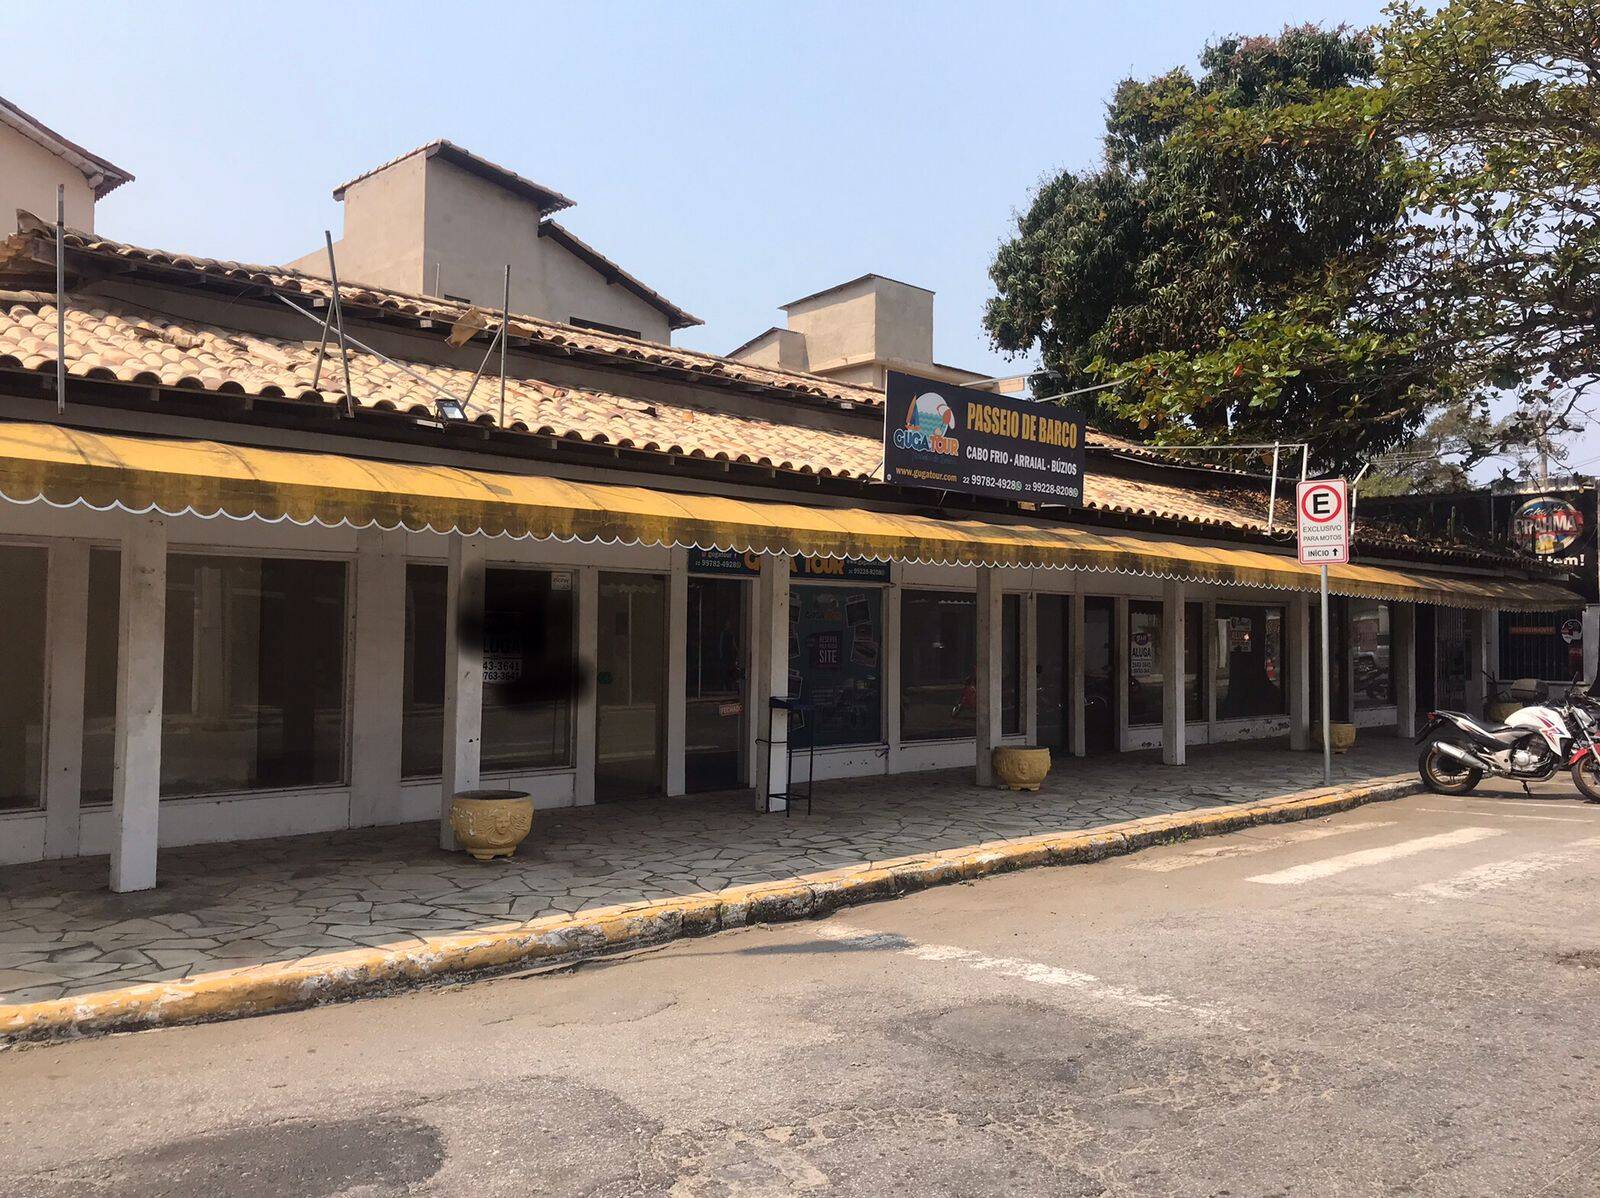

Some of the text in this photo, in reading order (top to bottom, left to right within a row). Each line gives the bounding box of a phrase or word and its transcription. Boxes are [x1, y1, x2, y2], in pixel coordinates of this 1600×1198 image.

[967, 402, 1077, 449] PASSEIO DE BARCO
[966, 446, 988, 461] CABO
[990, 449, 1008, 464] FRIO
[1014, 454, 1046, 471] ARRAIAL
[1051, 457, 1077, 475] BÚZIOS
[963, 476, 970, 484] 22
[971, 474, 1016, 491] 99782-4928
[1313, 493, 1330, 514] E
[1302, 524, 1342, 533] EXCLUSIVO
[1513, 515, 1577, 534] BRAHMA
[1308, 549, 1330, 557] INÍCIO
[804, 557, 845, 576] TOUR
[819, 649, 838, 663] SITE
[1132, 647, 1152, 657] ALUGA
[482, 672, 520, 681] 763-3641
